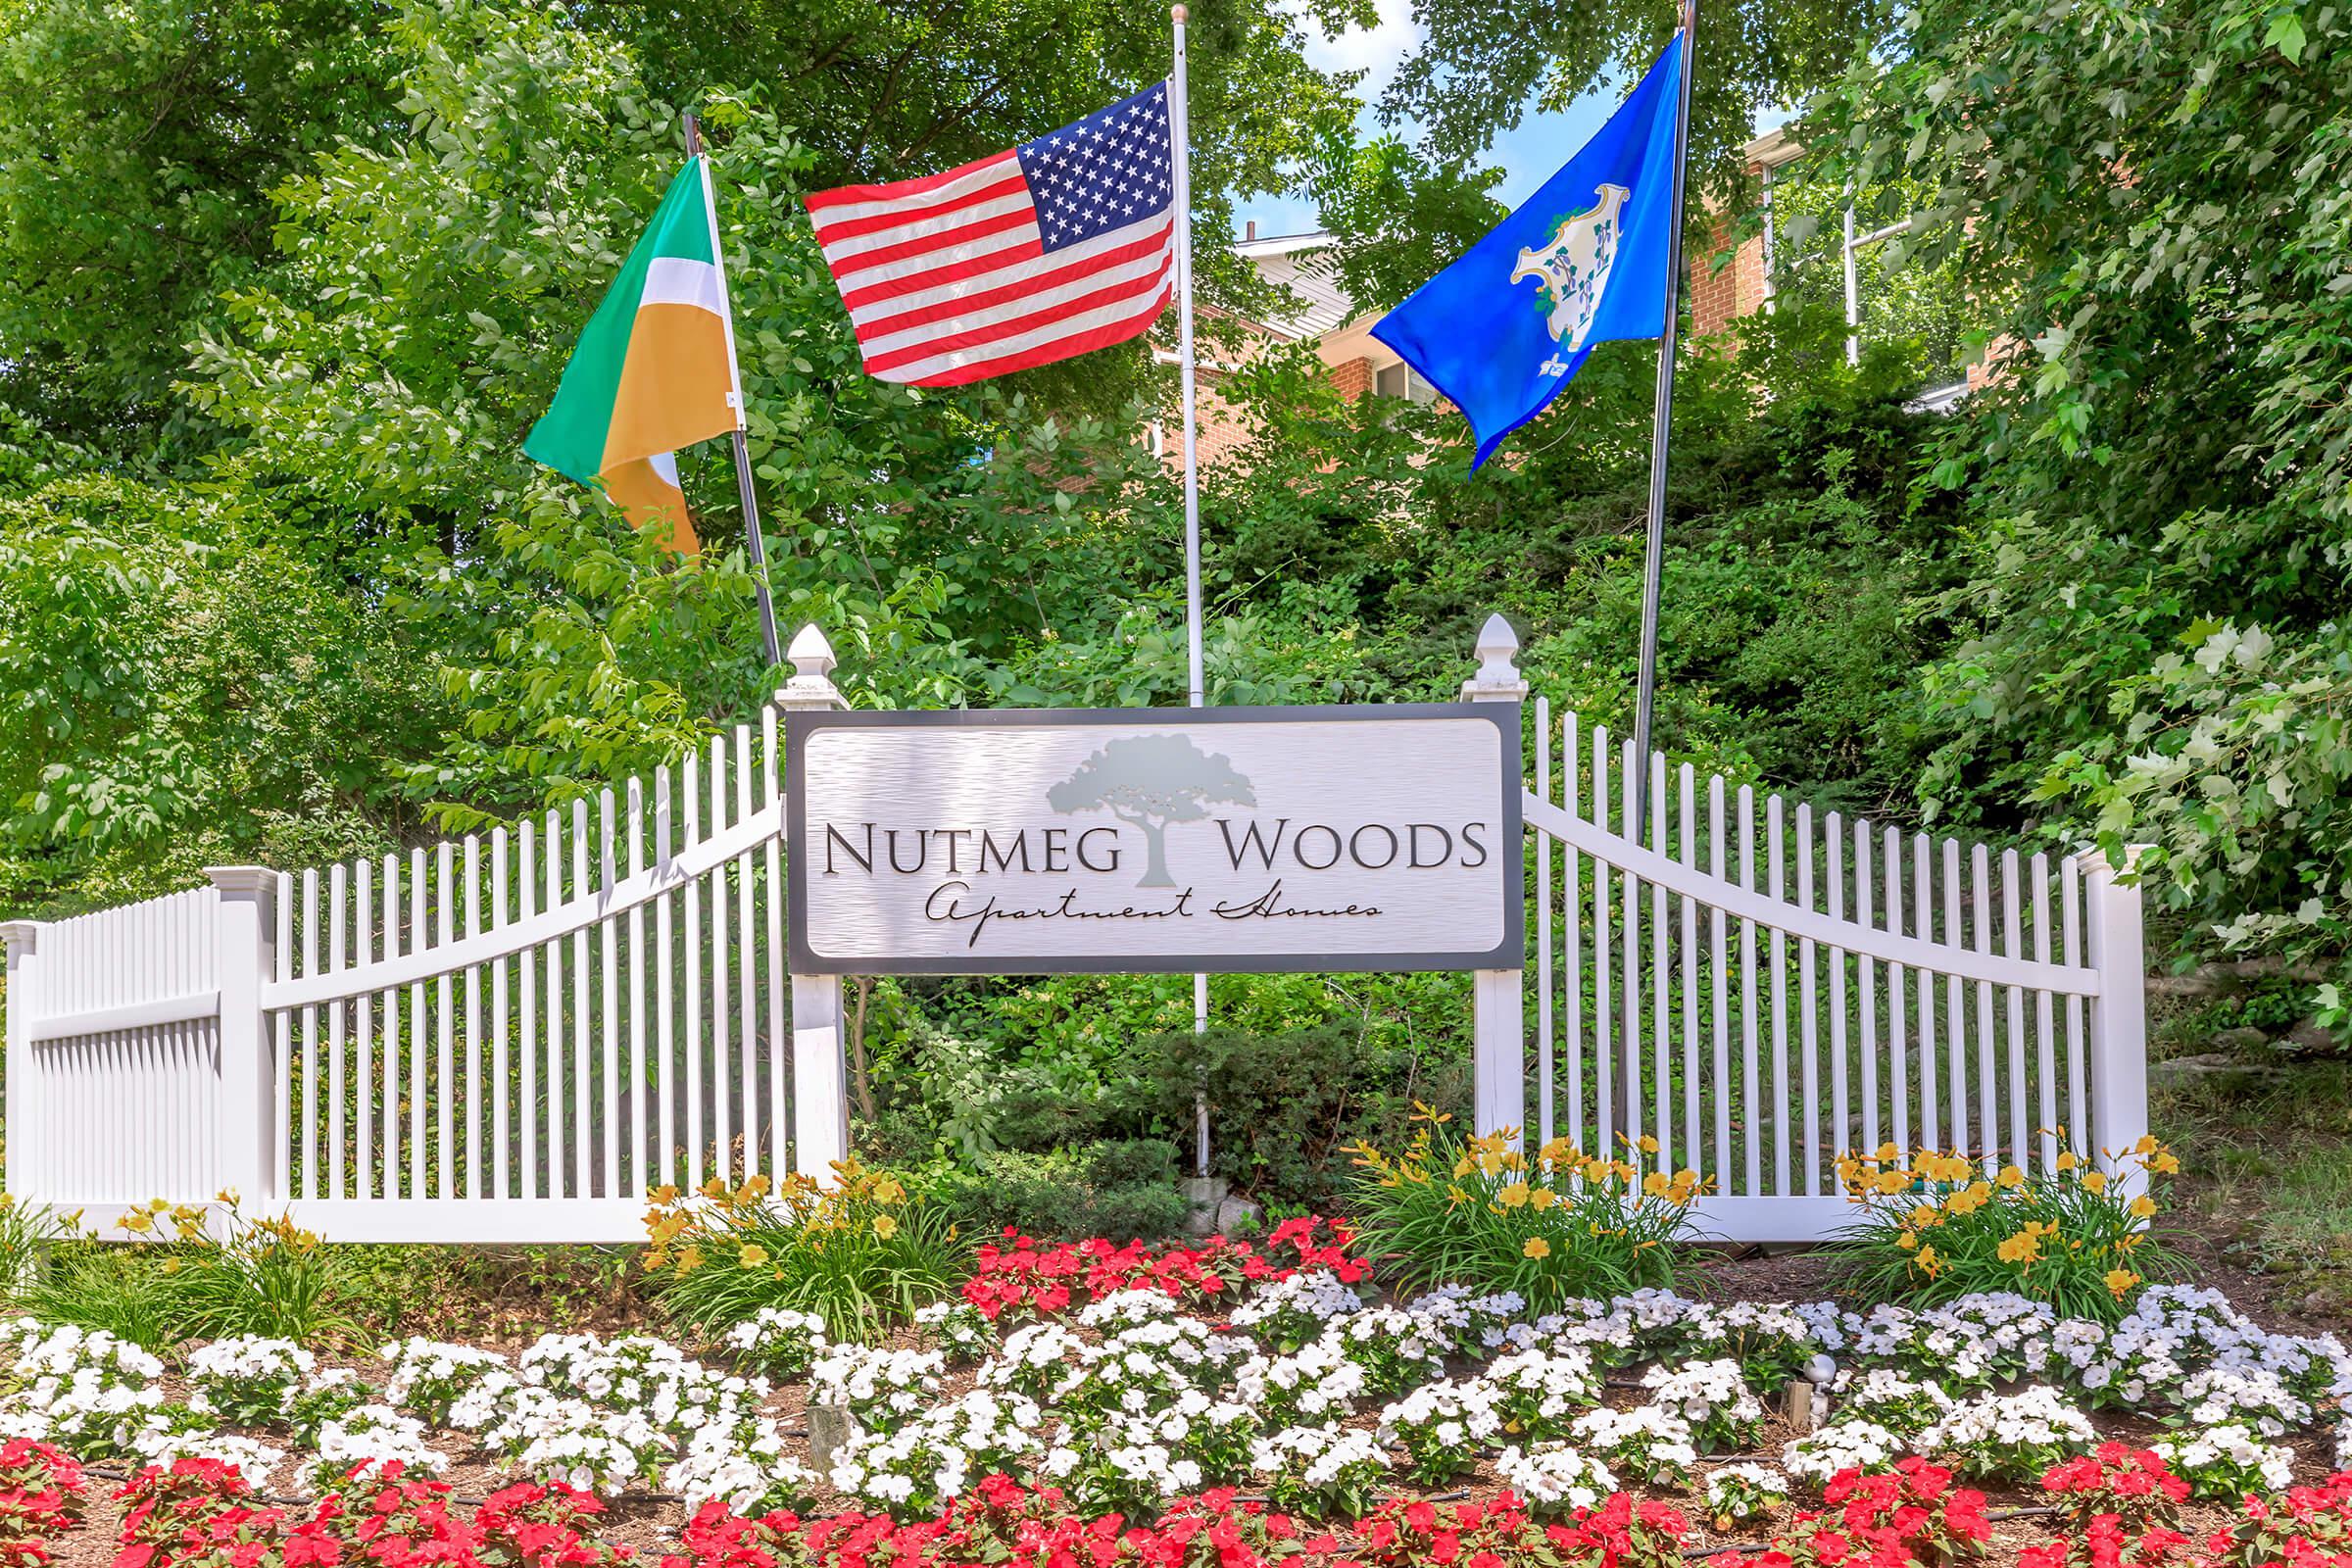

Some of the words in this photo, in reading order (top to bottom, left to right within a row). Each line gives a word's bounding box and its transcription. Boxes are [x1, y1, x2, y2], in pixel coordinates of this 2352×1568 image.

[823, 821, 1122, 874] NUTMEG
[1212, 816, 1489, 870] WOODS
[924, 881, 1193, 949] Apartment
[1208, 879, 1384, 919] Homes
